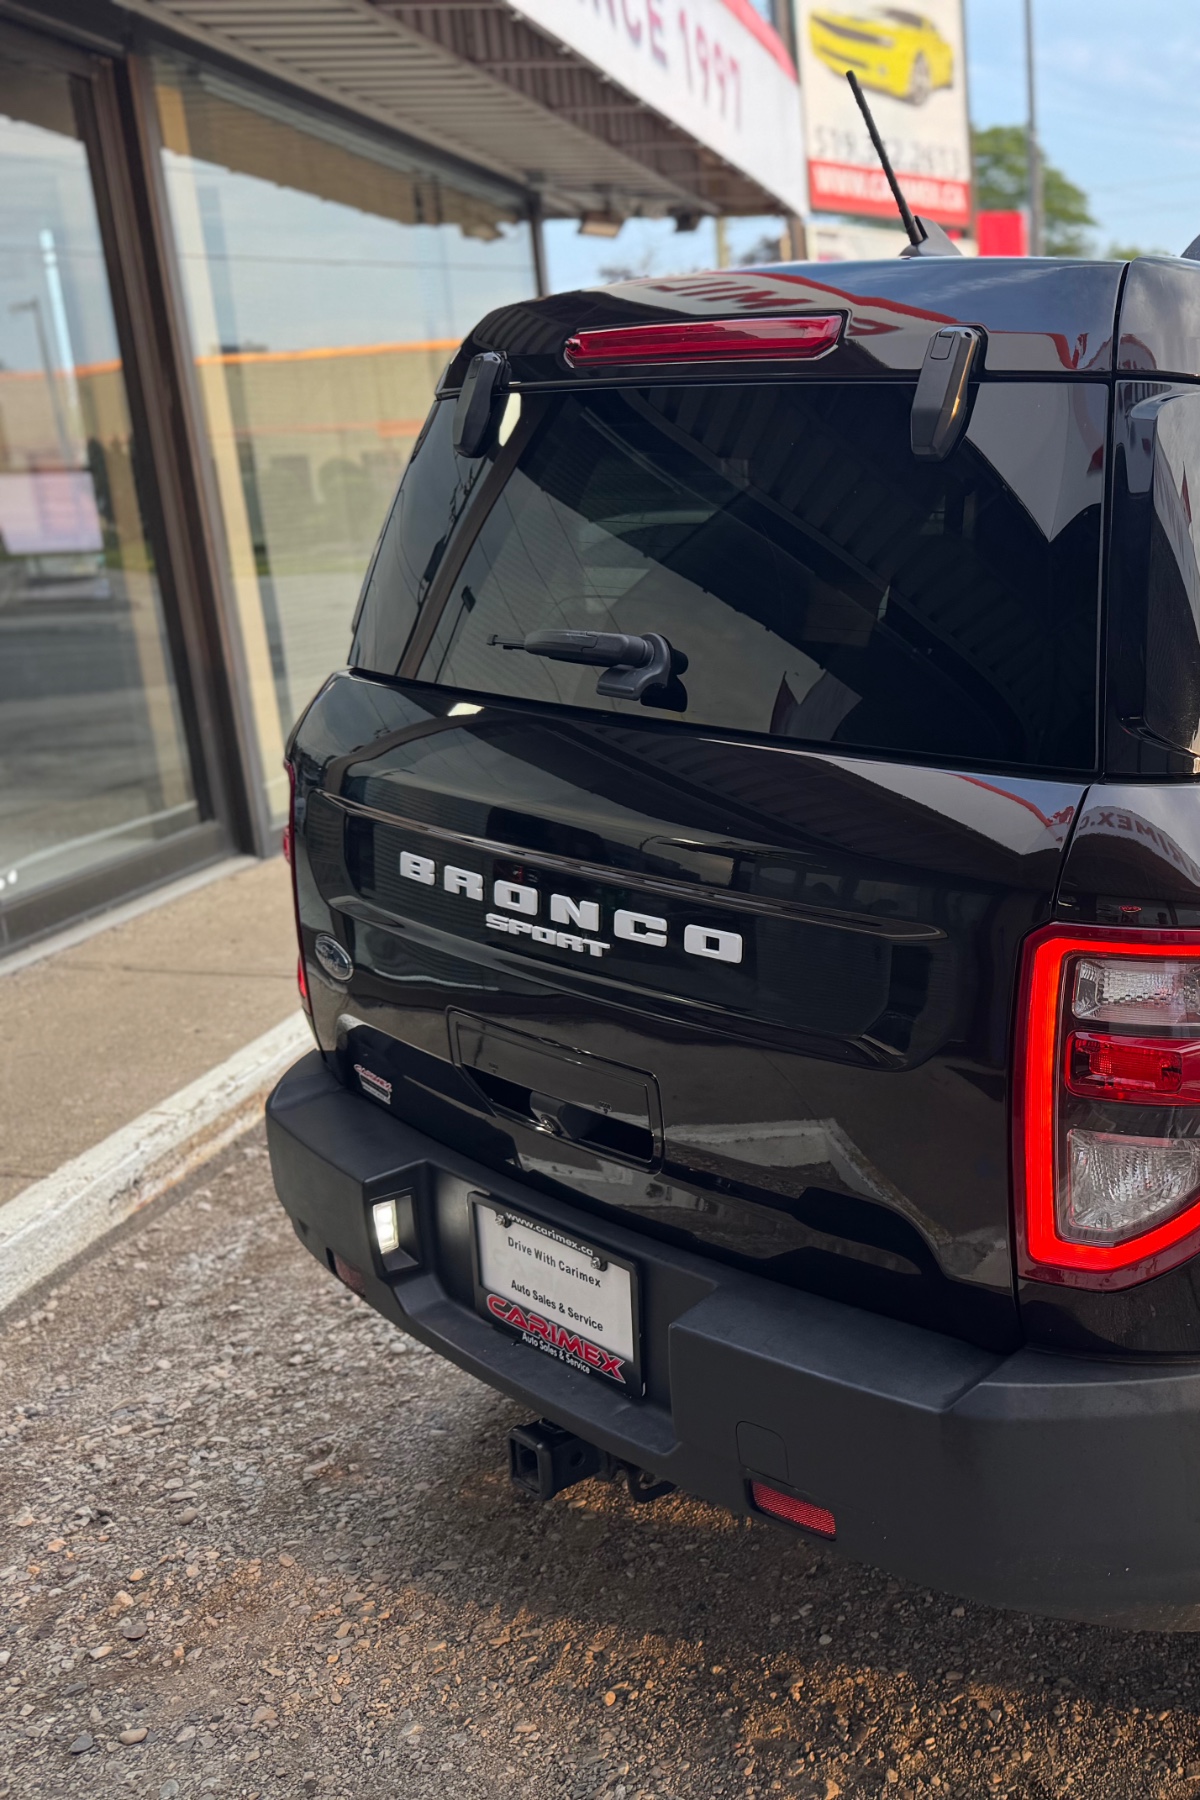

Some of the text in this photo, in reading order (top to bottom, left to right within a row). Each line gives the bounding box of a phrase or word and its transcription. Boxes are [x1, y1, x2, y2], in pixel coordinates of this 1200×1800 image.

[678, 8, 742, 134] 1997
[400, 850, 744, 964] BRONCO
[486, 912, 611, 957] SPORT
[505, 1212, 594, 1257] www.carimex.ca
[508, 1236, 601, 1288] Drive With Carimex
[511, 1279, 604, 1332] Auto Sales & Service
[487, 1294, 624, 1382] CARIMEX
[522, 1332, 591, 1374] Auto Sales & Service
